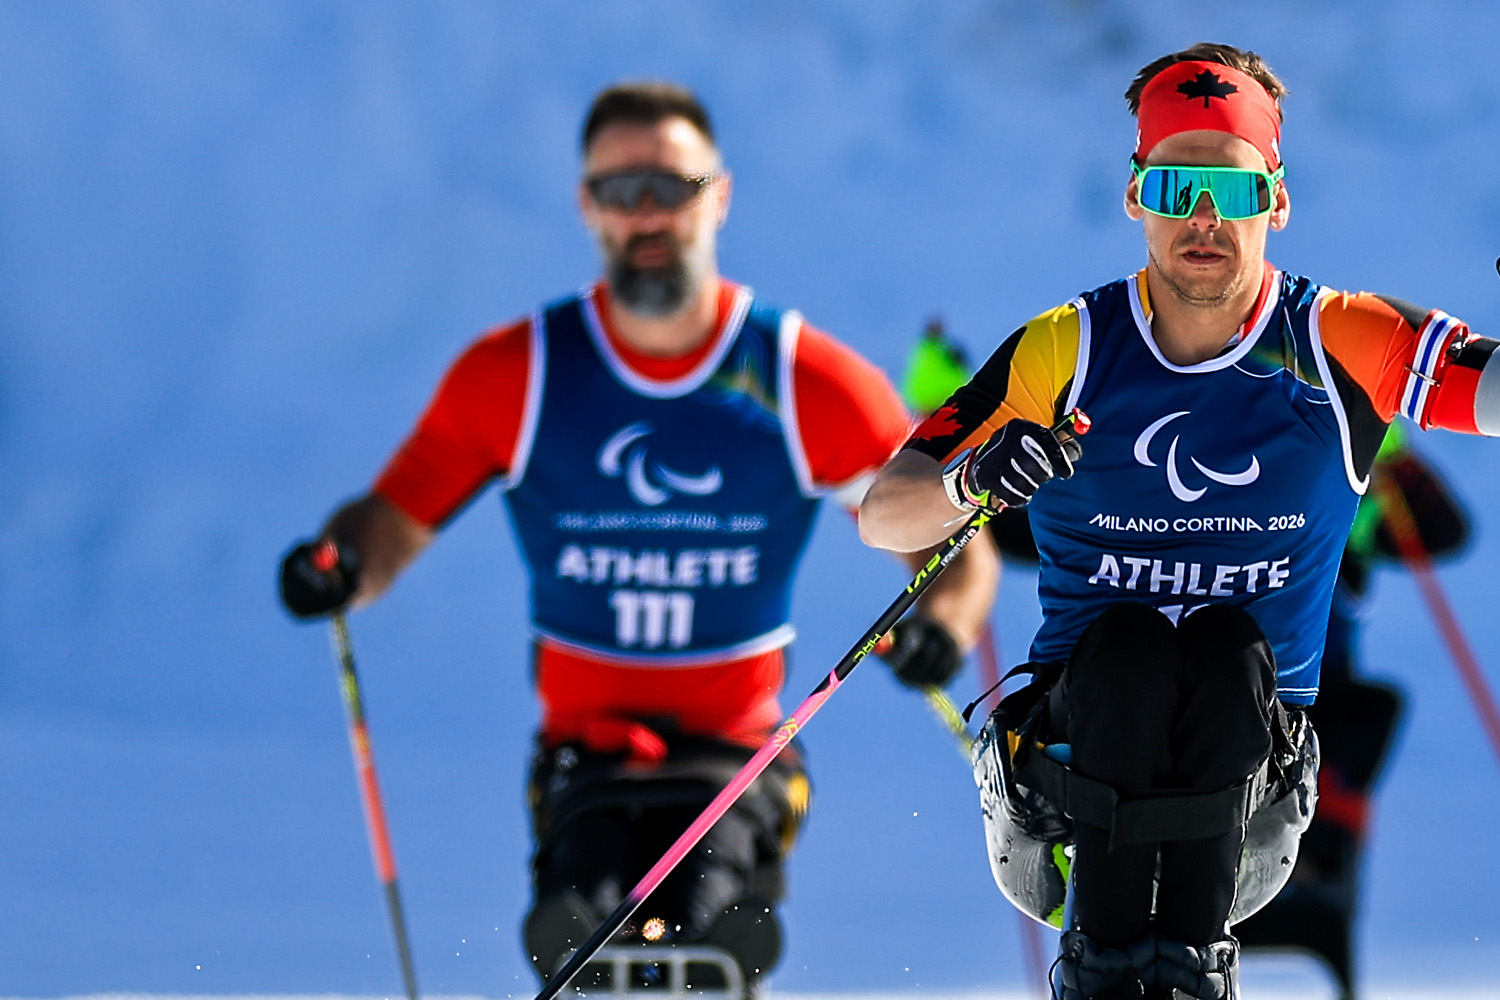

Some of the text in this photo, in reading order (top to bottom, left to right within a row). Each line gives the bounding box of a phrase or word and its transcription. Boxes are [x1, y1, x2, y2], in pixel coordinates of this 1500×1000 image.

[1089, 513, 1306, 532] MILANO CORTINA 2026
[556, 544, 760, 587] ATHLETE
[1088, 554, 1290, 597] ATHLETE
[609, 590, 695, 648] 111
